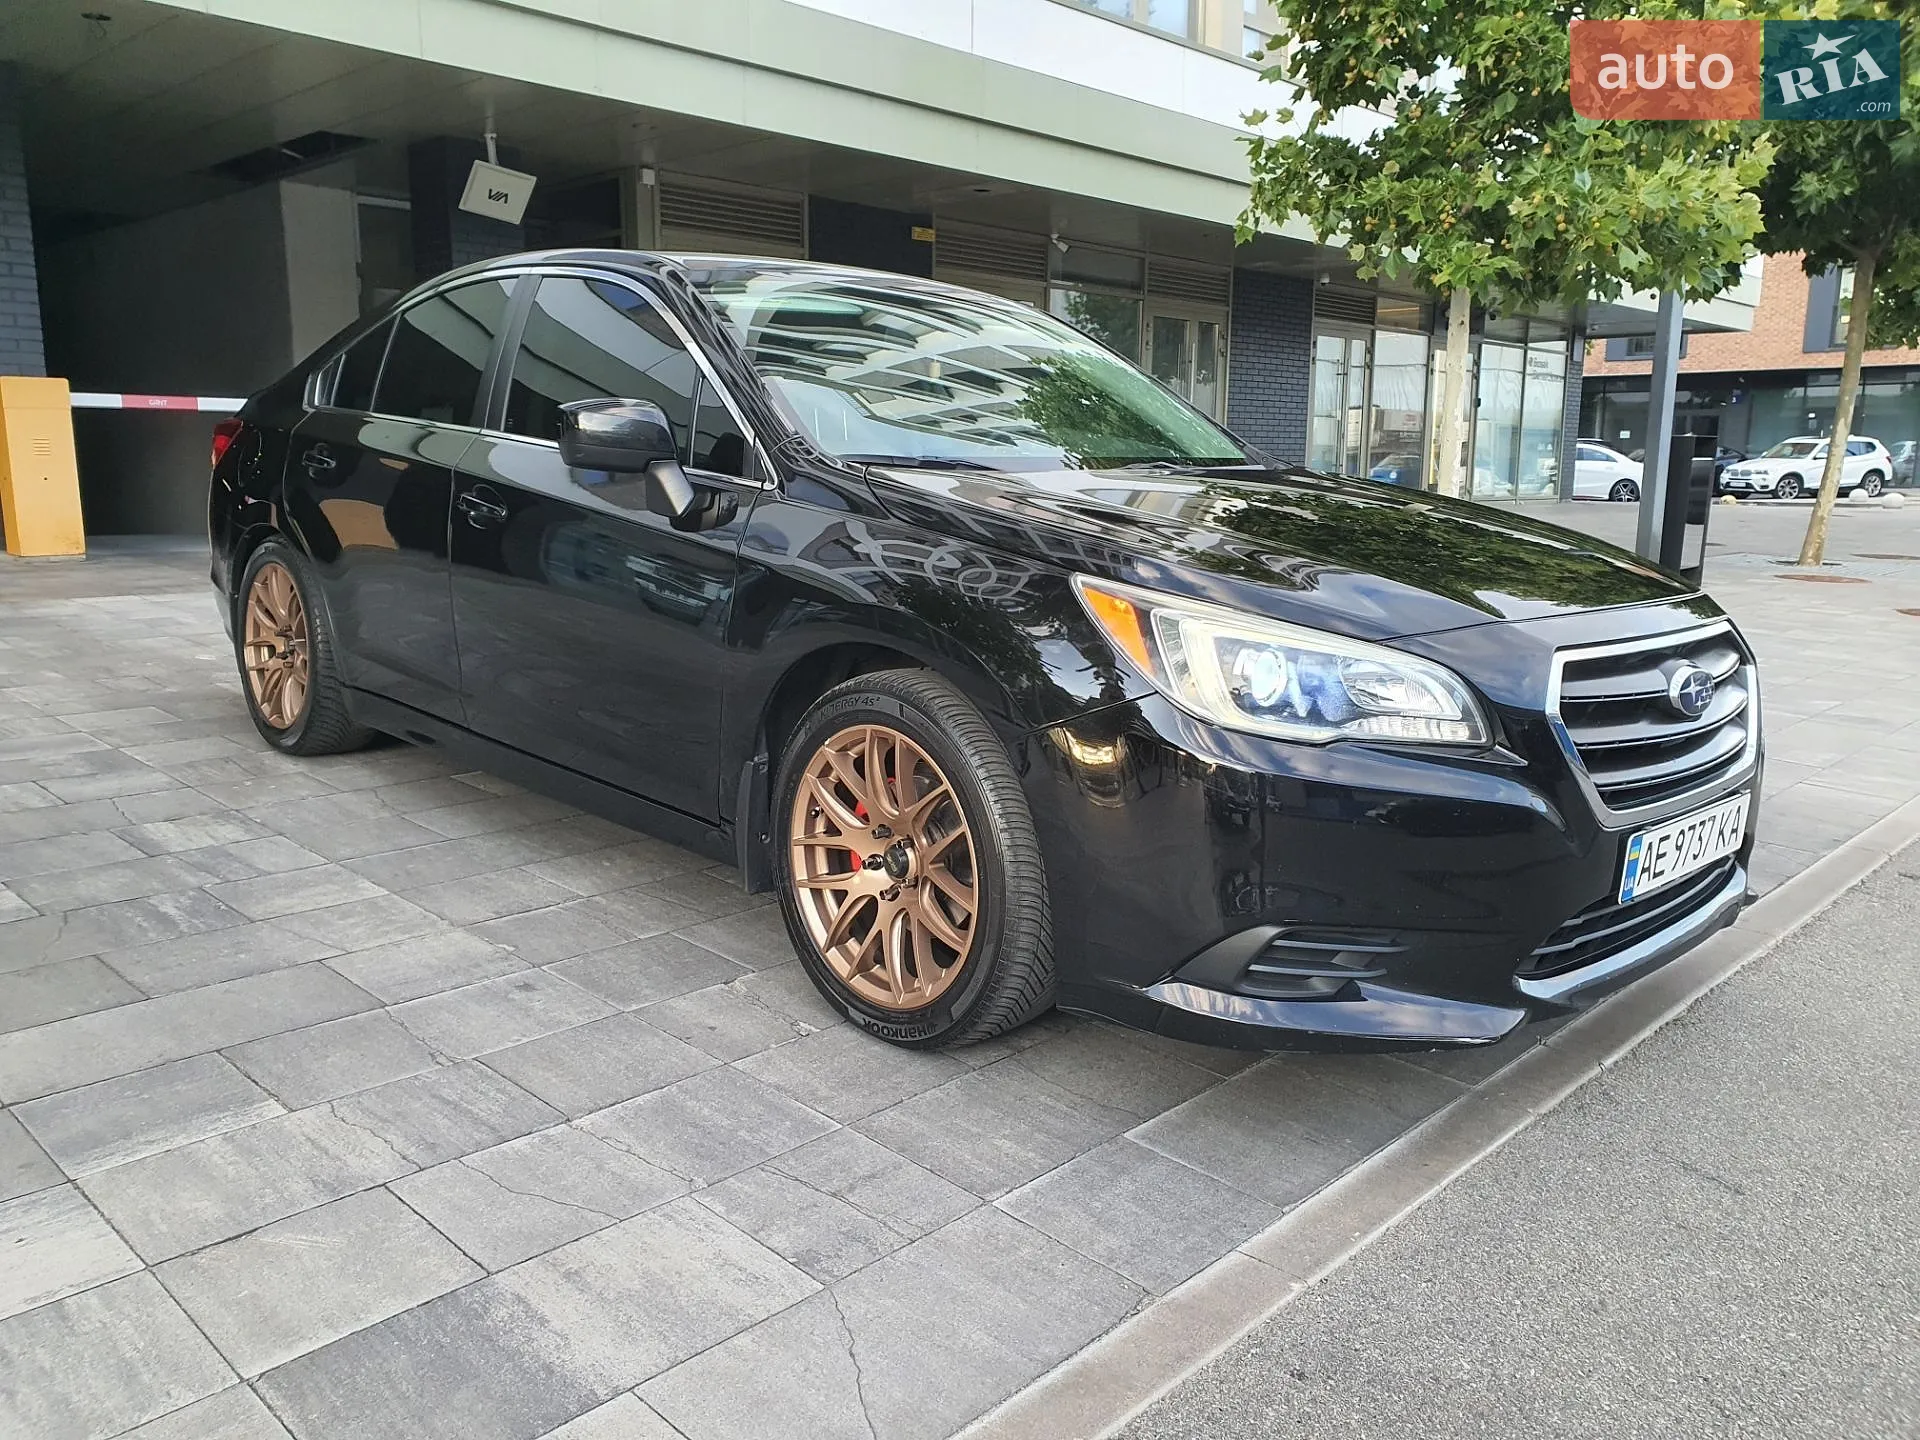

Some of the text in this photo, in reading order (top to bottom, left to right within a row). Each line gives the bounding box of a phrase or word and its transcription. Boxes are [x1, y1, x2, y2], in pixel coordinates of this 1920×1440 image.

[1637, 804, 1742, 887] AE 9737 KA
